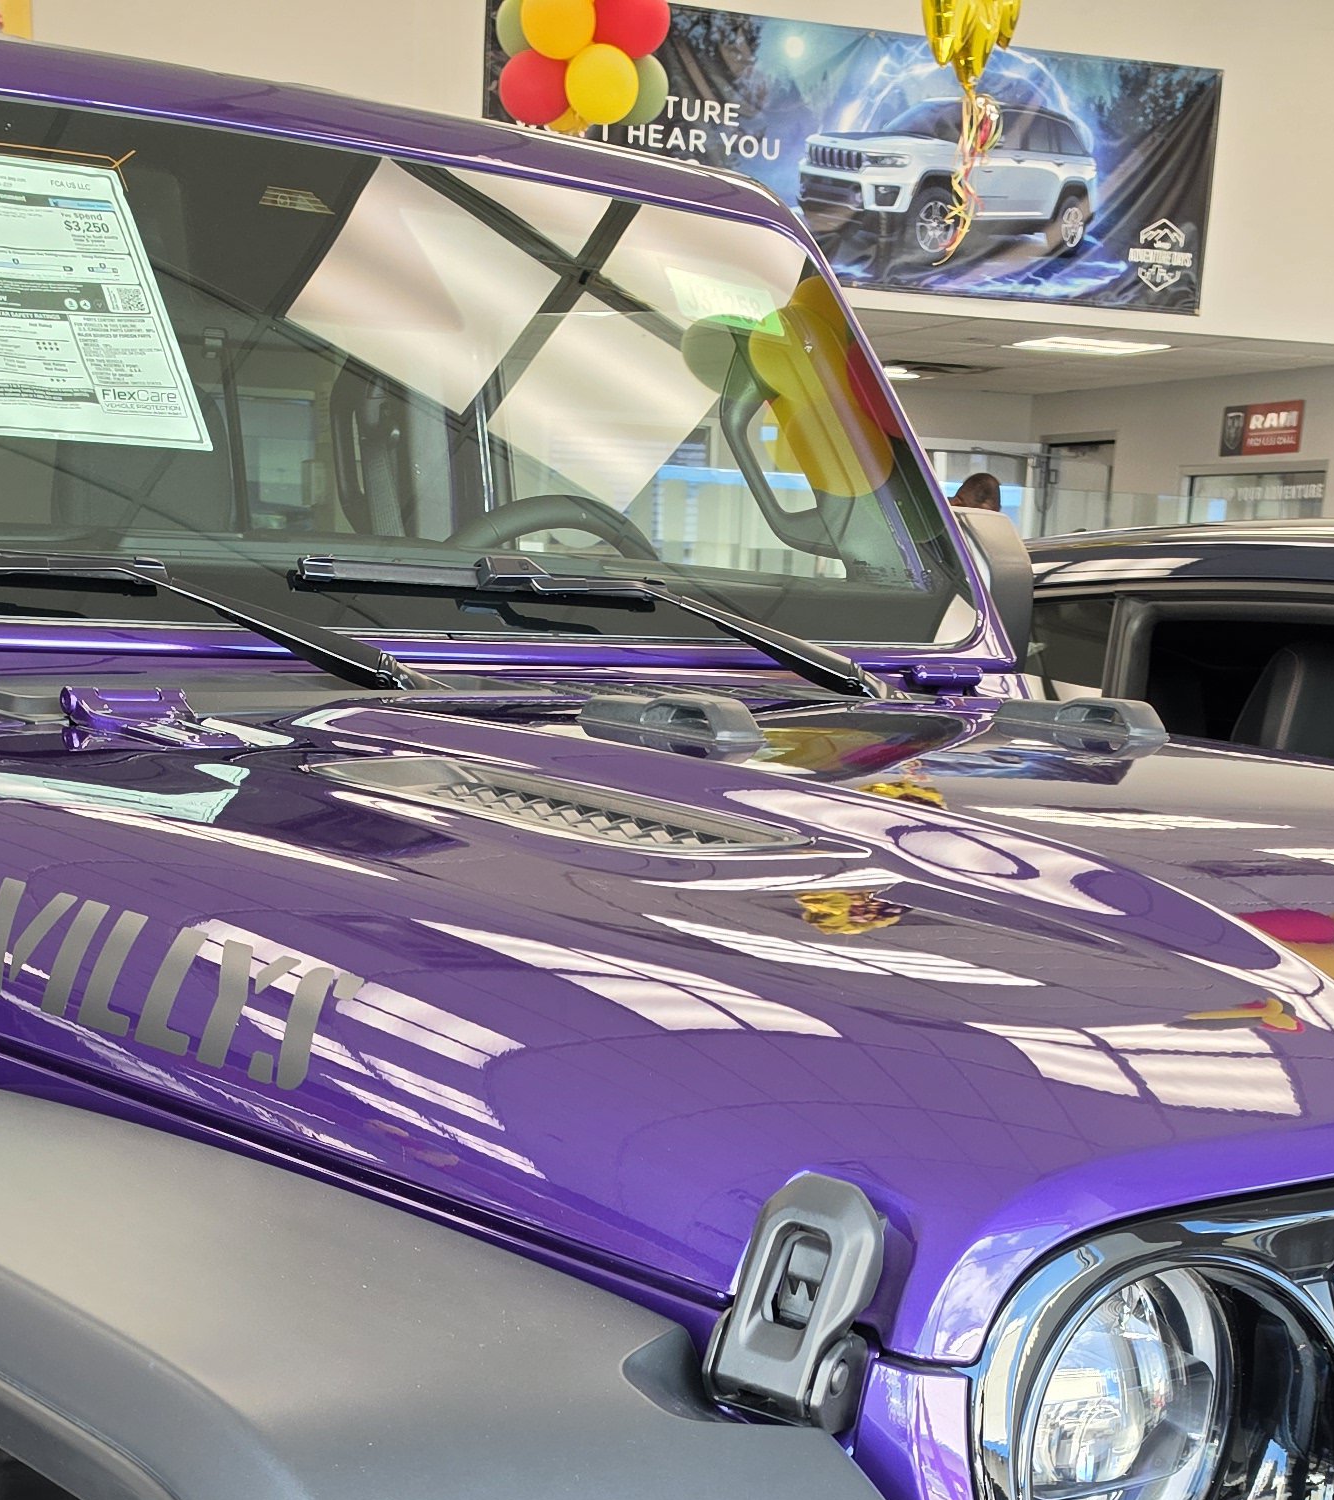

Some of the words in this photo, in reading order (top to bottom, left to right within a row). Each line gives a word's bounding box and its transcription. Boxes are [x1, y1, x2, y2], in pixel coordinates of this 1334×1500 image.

[664, 95, 741, 127] TURE
[627, 124, 707, 153] HEAR
[719, 131, 781, 161] YOU
[50, 179, 66, 189] FCA
[66, 181, 77, 190] US
[77, 182, 91, 191] LLC
[73, 211, 103, 222] spend
[63, 220, 110, 234] $3,250
[101, 388, 177, 402] FlexCare
[135, 403, 181, 411] PROTECTION
[1249, 410, 1300, 430] RAM
